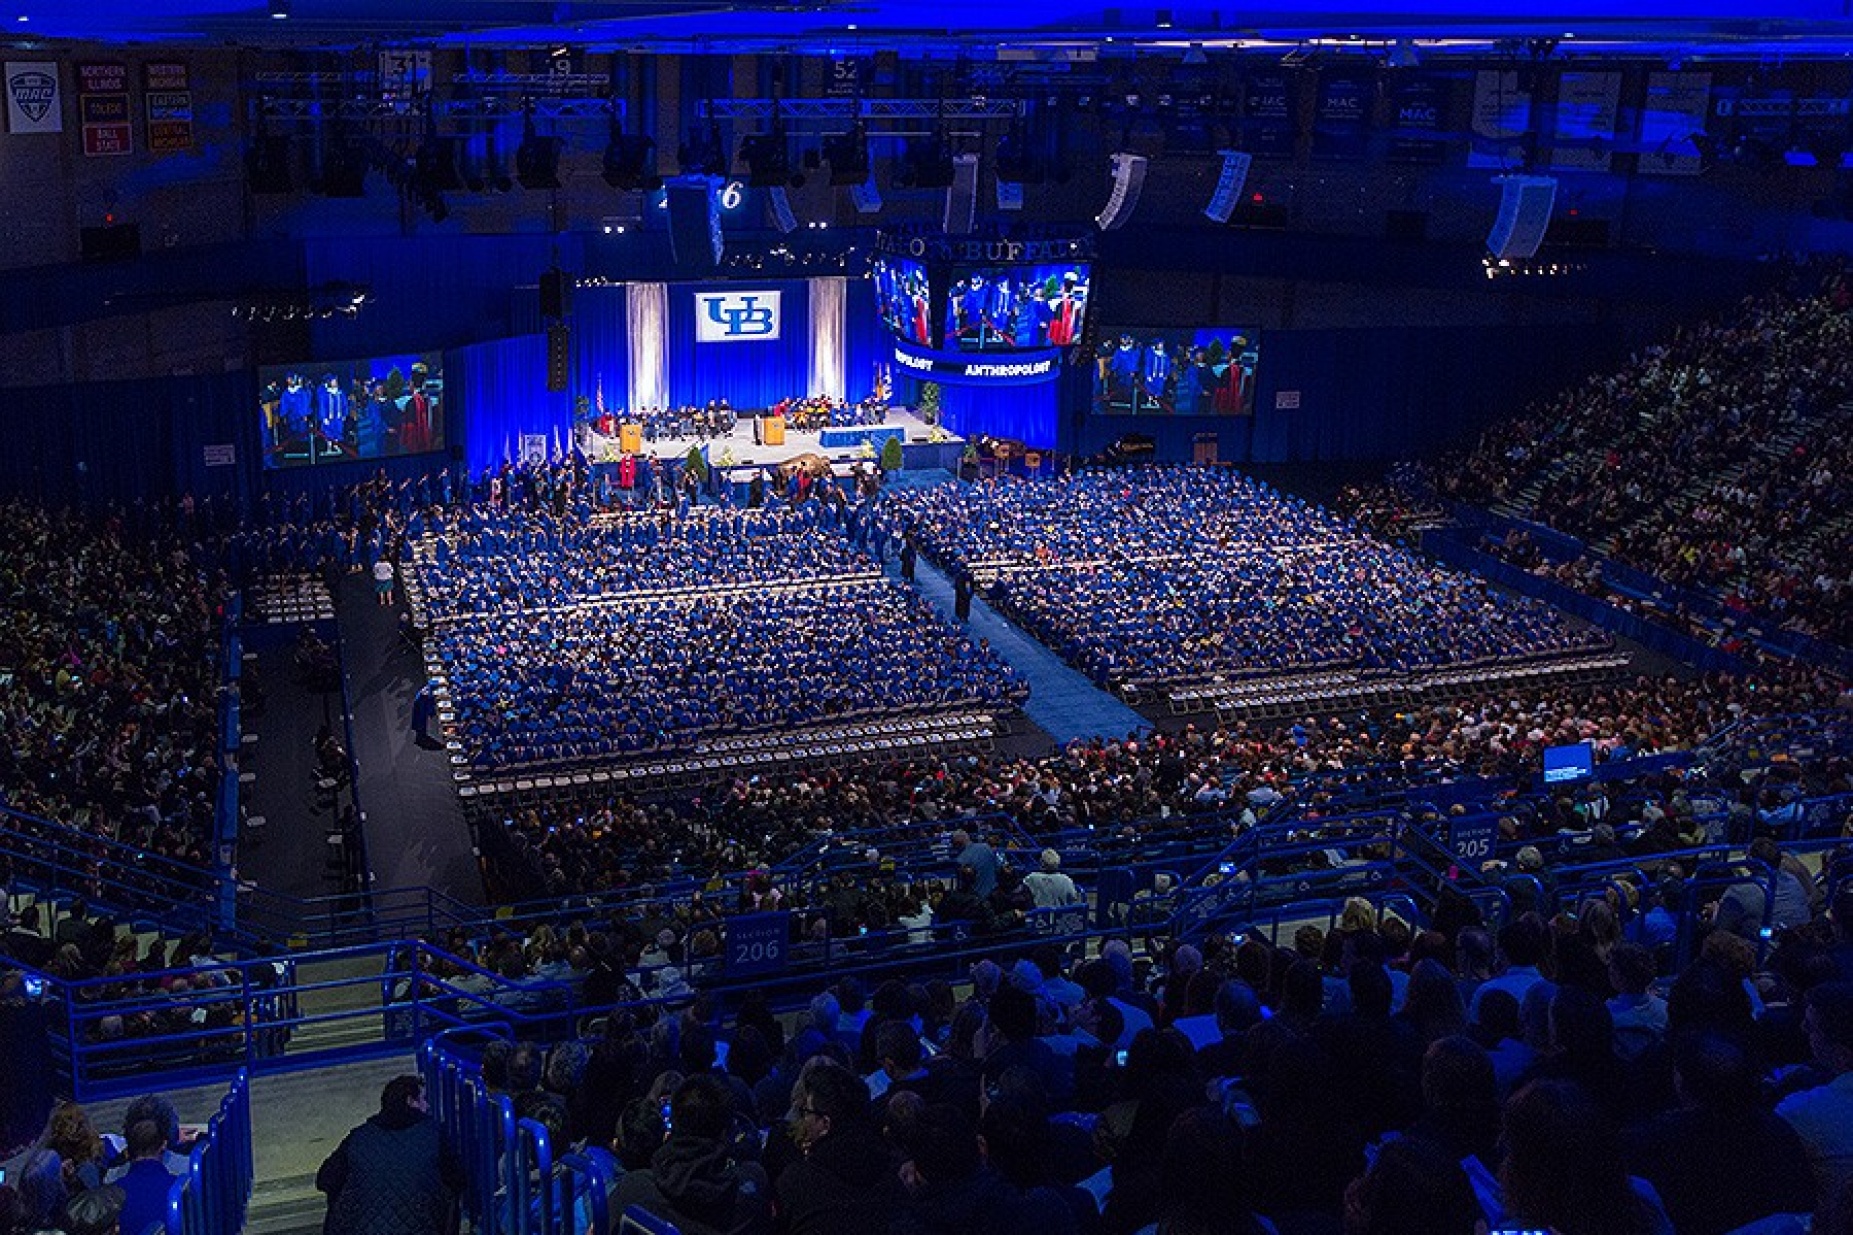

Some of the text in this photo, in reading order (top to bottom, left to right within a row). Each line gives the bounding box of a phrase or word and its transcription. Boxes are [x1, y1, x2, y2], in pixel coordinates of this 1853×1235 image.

[833, 60, 858, 79] 52
[15, 87, 53, 100] MAC
[1327, 98, 1358, 108] MAC
[1399, 108, 1437, 120] MAC
[965, 238, 1081, 261] BUFFALO
[702, 297, 773, 336] UB
[964, 360, 1051, 377] ANTHROPOLOGY
[1456, 838, 1490, 859] 205
[735, 939, 779, 964] 206
